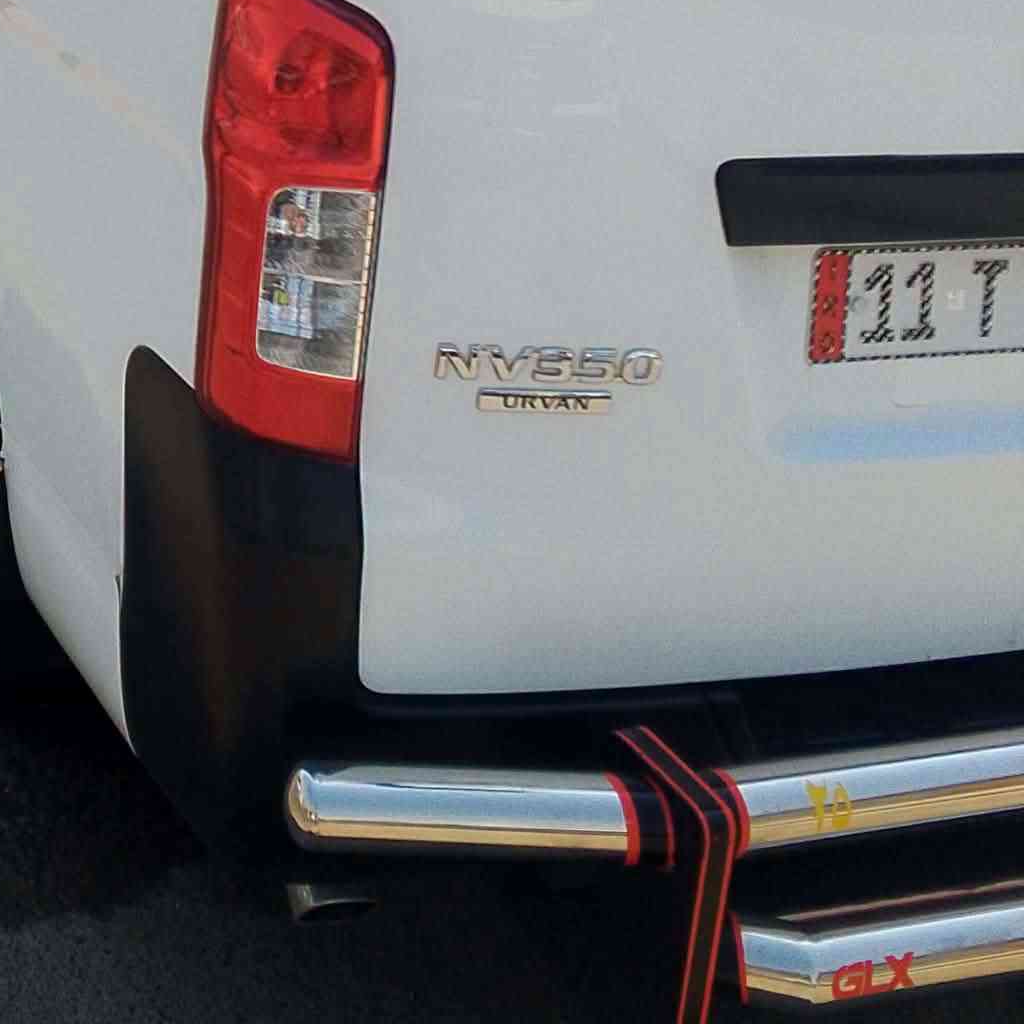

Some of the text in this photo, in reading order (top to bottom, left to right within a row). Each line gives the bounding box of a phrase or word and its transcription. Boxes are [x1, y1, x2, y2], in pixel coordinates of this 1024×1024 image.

[859, 262, 937, 344] 11
[432, 342, 664, 385] NV350
[501, 395, 592, 410] URVAN
[831, 952, 915, 999] GLX
